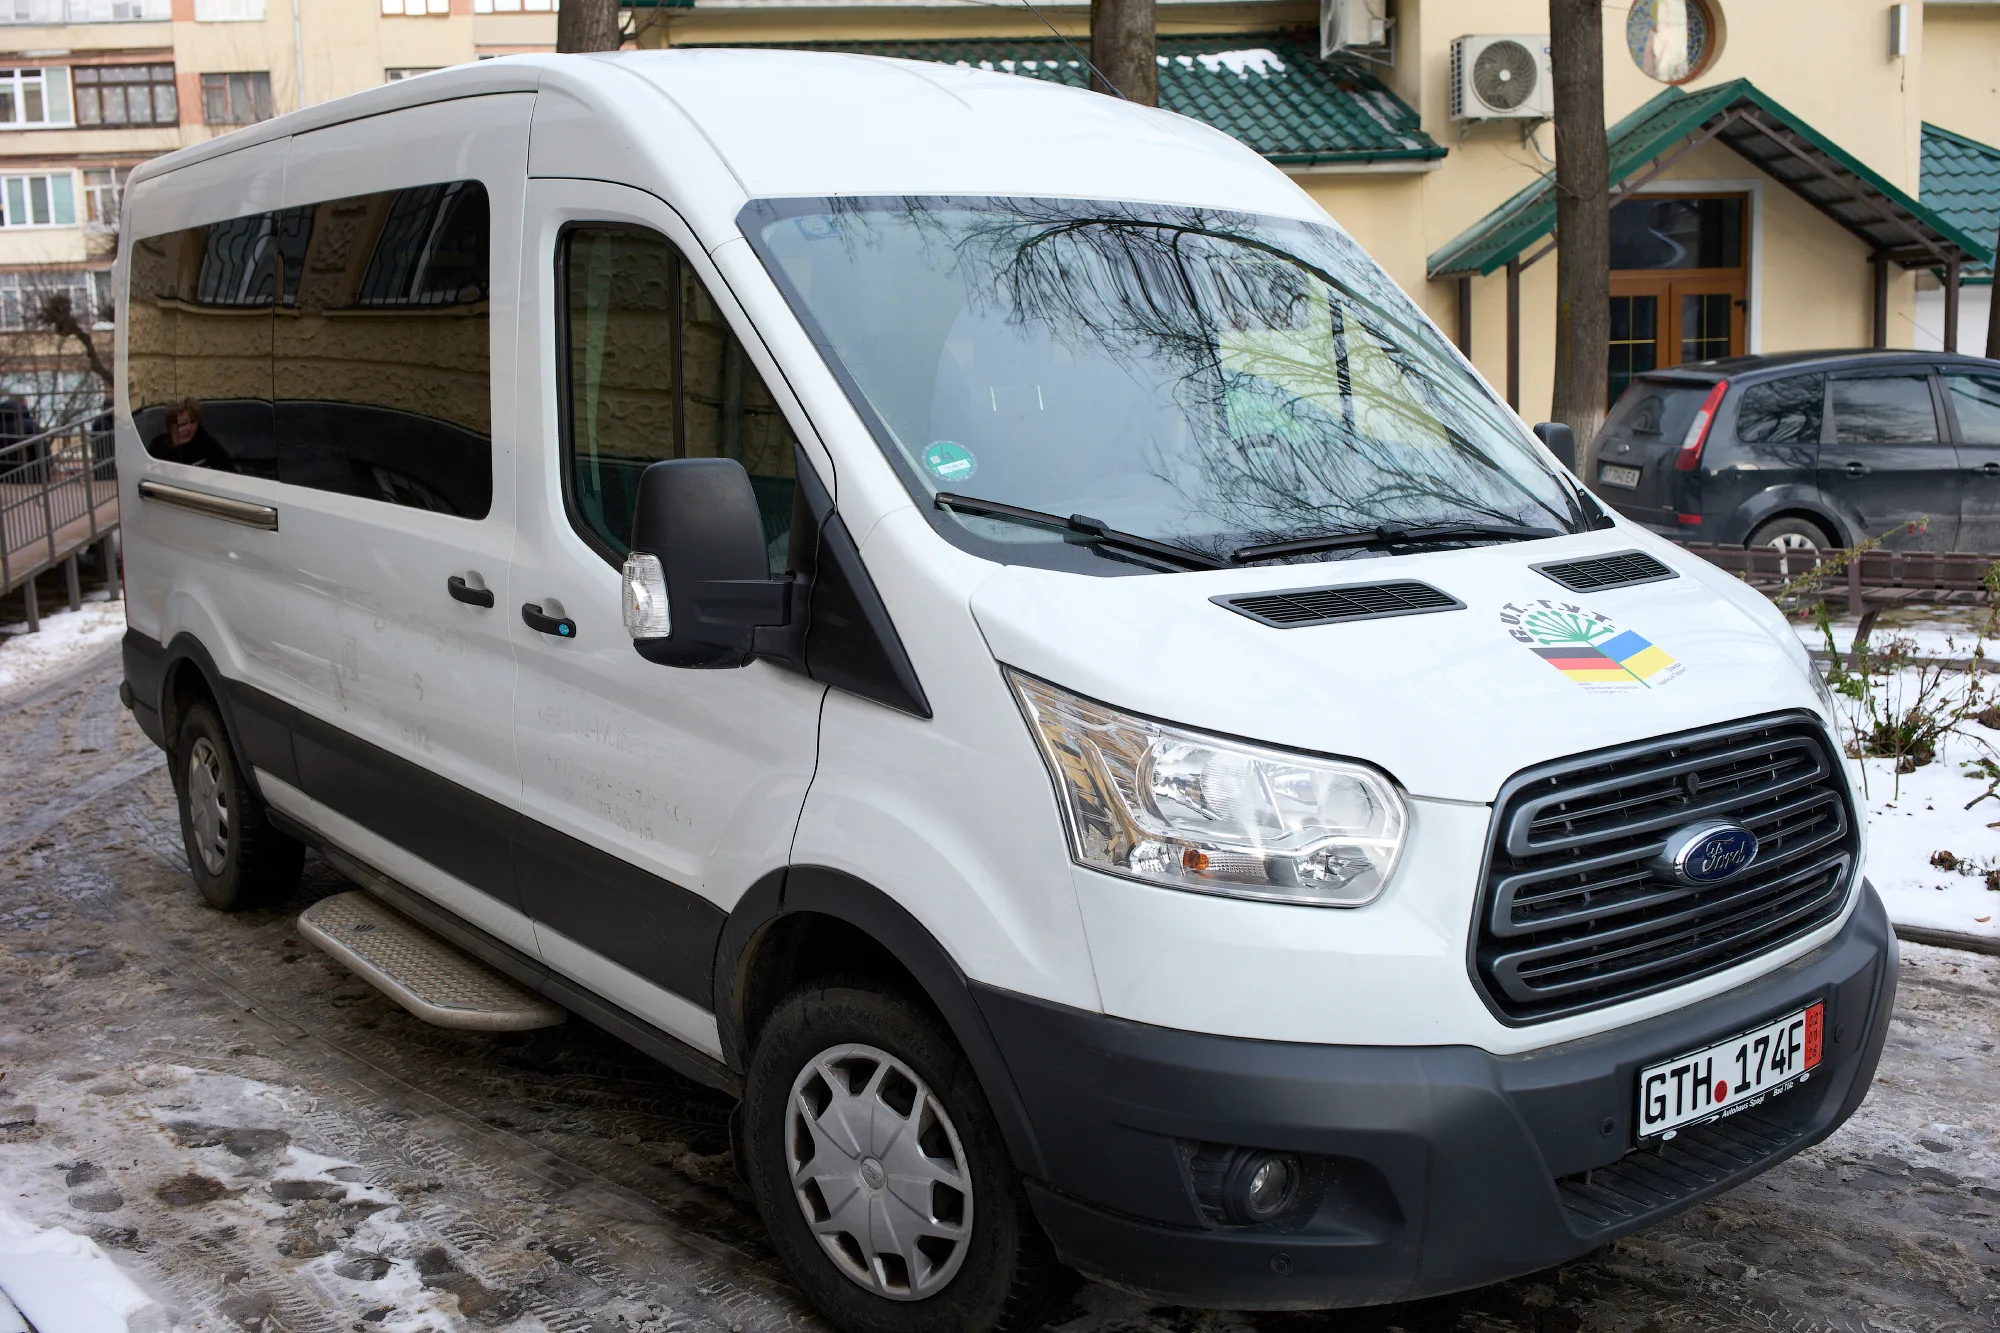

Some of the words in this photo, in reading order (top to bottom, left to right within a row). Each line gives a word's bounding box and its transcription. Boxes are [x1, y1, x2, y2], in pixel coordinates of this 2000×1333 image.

[1701, 836, 1746, 874] Ford
[1645, 1056, 1713, 1125] GTH
[1733, 1019, 1804, 1095] 174F
[1721, 1102, 1749, 1118] Autohaus
[1772, 1085, 1784, 1097] Bad
